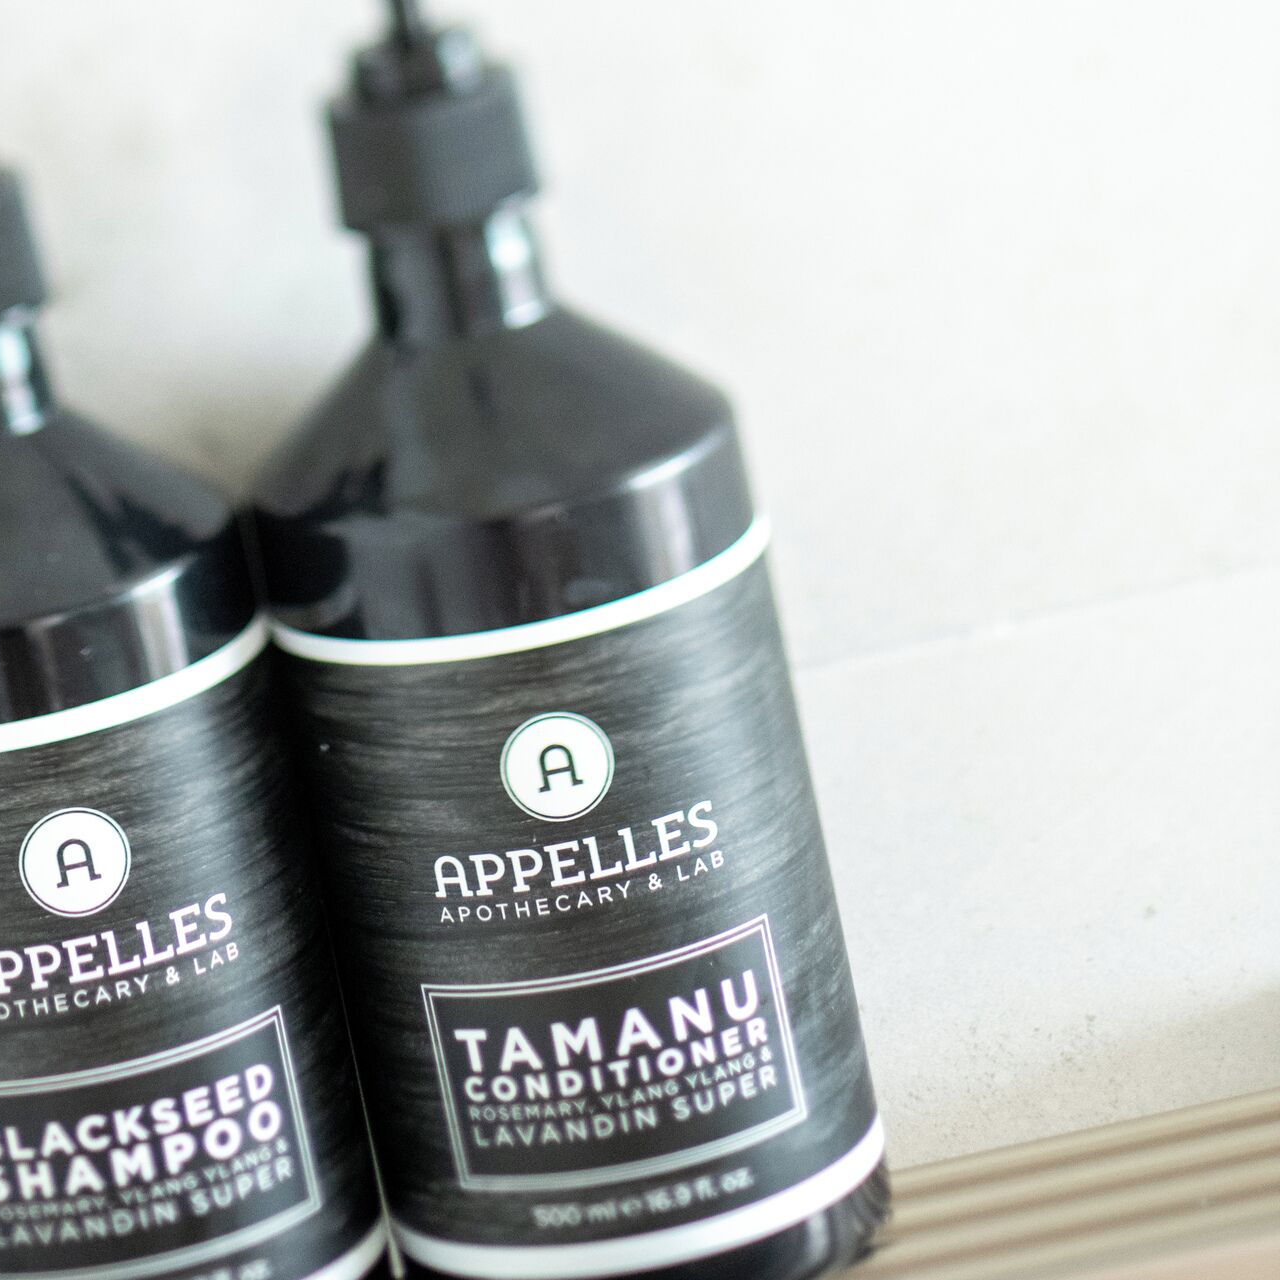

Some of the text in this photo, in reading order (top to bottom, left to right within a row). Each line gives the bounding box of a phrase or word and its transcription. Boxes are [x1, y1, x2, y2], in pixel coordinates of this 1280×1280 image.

[539, 743, 583, 792] A
[56, 838, 101, 888] A
[434, 800, 718, 898] APPELLES
[440, 850, 725, 923] APOTHECARY & LAB
[166, 966, 180, 985] &
[193, 942, 239, 975] LAB
[454, 970, 759, 1072] TAMANU
[465, 1017, 768, 1102] CONDITIONER
[470, 1045, 772, 1122] ROSEMARY, YLANG YLANG &
[472, 1065, 776, 1148] LAVANDIN SUPER
[121, 1176, 197, 1205] YLANG
[204, 1147, 272, 1183] YLANG
[190, 1157, 293, 1215] SUPER
[533, 1203, 582, 1227] 500
[586, 1200, 616, 1222] ml
